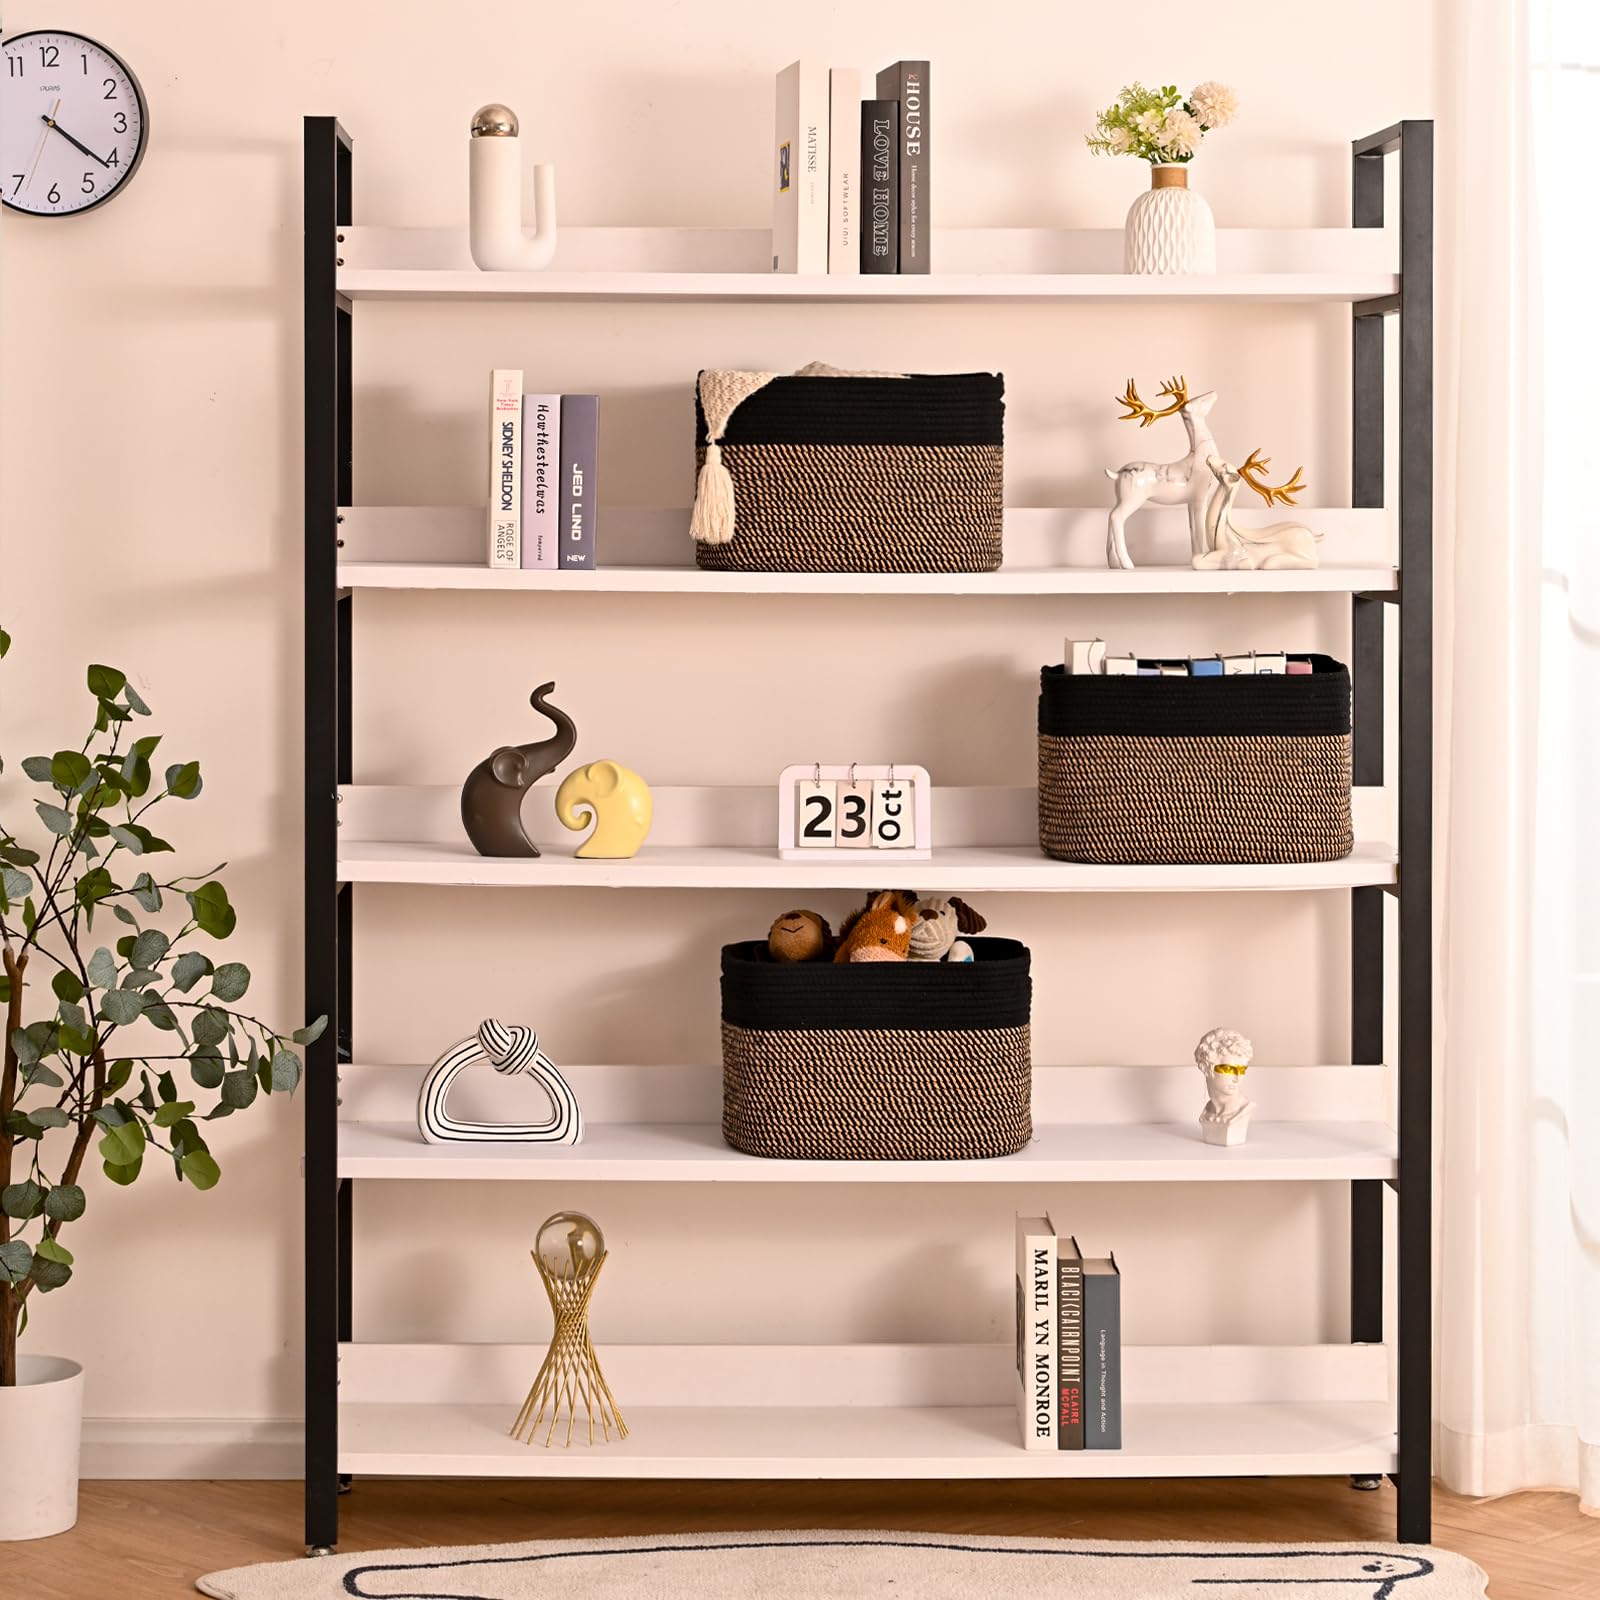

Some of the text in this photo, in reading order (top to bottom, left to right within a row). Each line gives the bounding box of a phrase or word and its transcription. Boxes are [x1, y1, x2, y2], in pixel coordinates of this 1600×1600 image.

[7, 56, 23, 77] 11
[39, 46, 60, 67] 12
[81, 54, 87, 75] 1
[103, 78, 117, 100] 2
[113, 112, 128, 133] 3
[906, 81, 921, 156] HOUSE
[106, 147, 120, 167] 4
[807, 126, 817, 173] MATISSE
[12, 174, 26, 195] 7
[47, 182, 61, 204] 6
[81, 172, 95, 194] 5
[872, 119, 890, 256] LOVE HOME
[501, 421, 514, 511] SIDNEY SHELDON
[571, 463, 583, 541] JED LIND
[497, 525, 505, 560] ANGELS
[506, 550, 514, 562] OF
[567, 554, 586, 562] NEW
[878, 789, 902, 841] Oct
[1035, 1353, 1050, 1438] MONROE
[1071, 1388, 1080, 1425] CLAIRE
[1061, 1388, 1070, 1426] MCFALL
